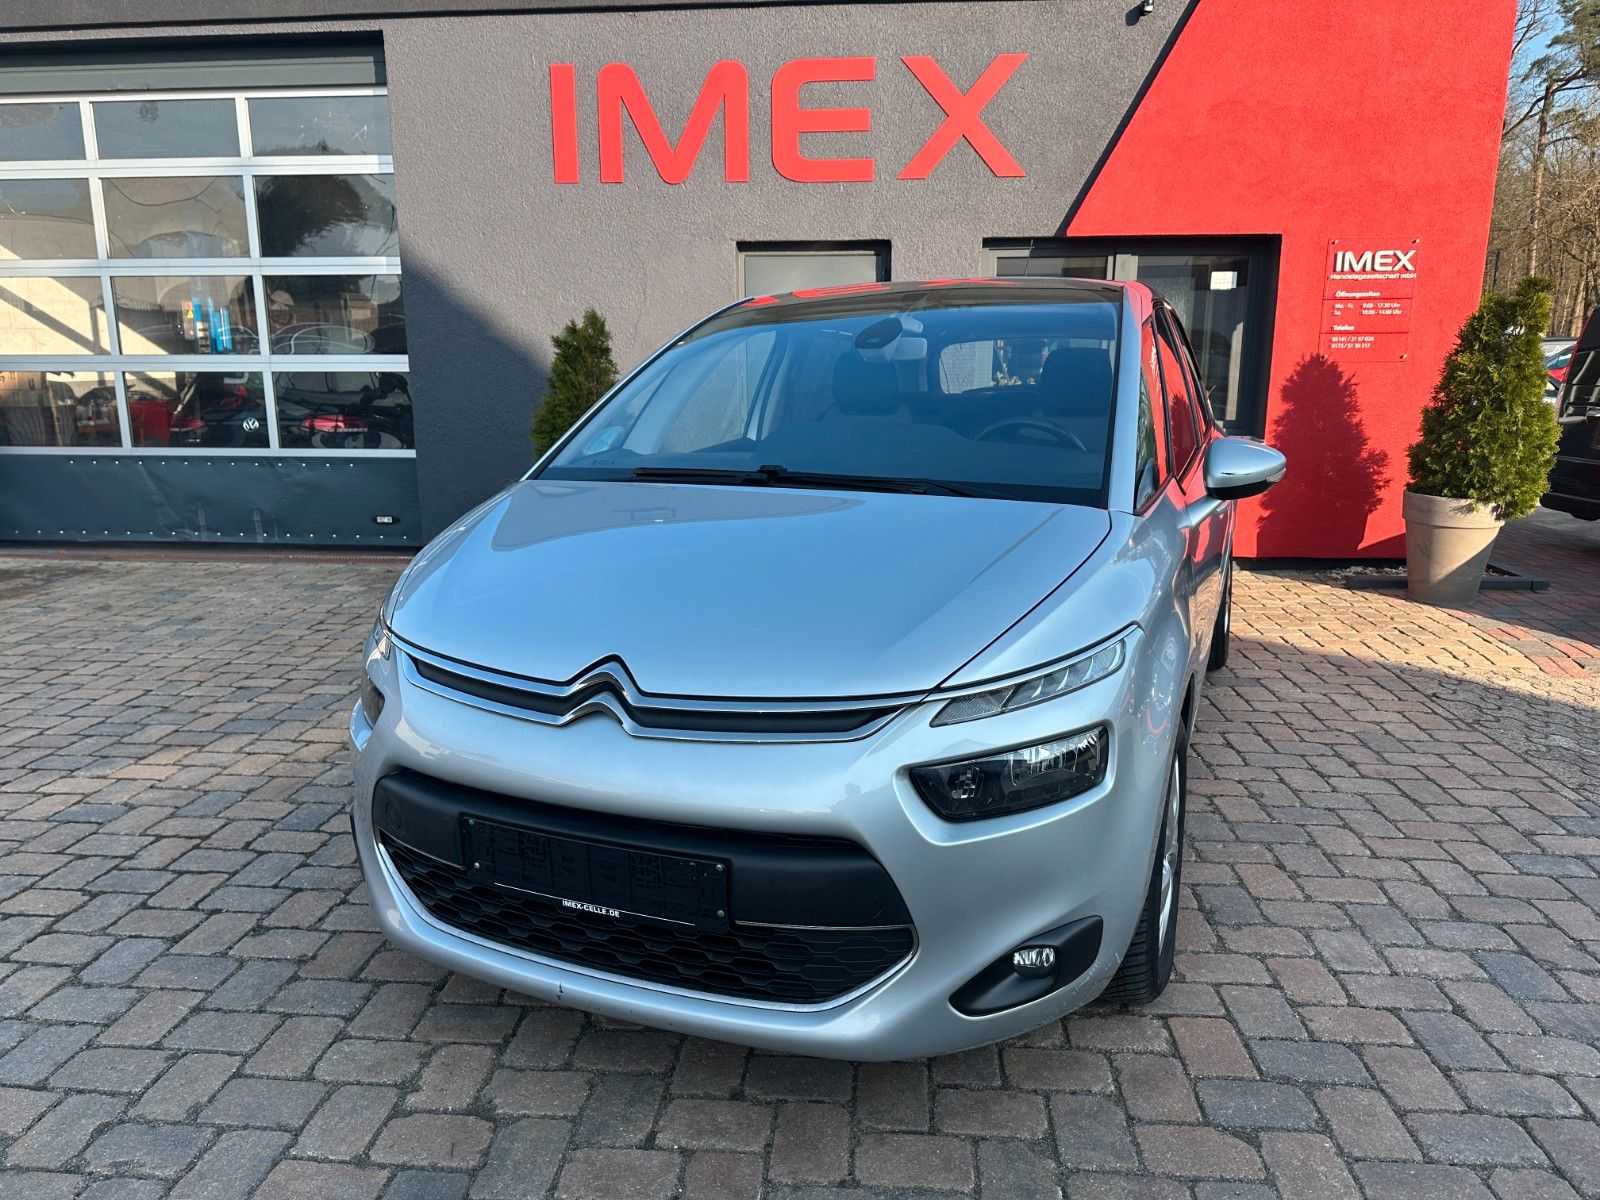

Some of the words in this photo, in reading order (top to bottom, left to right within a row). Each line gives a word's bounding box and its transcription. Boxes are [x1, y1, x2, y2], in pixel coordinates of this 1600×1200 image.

[550, 53, 1028, 184] IMEX
[1335, 250, 1416, 272] IMEX
[562, 899, 620, 918] IMEX-CELLE.DE
